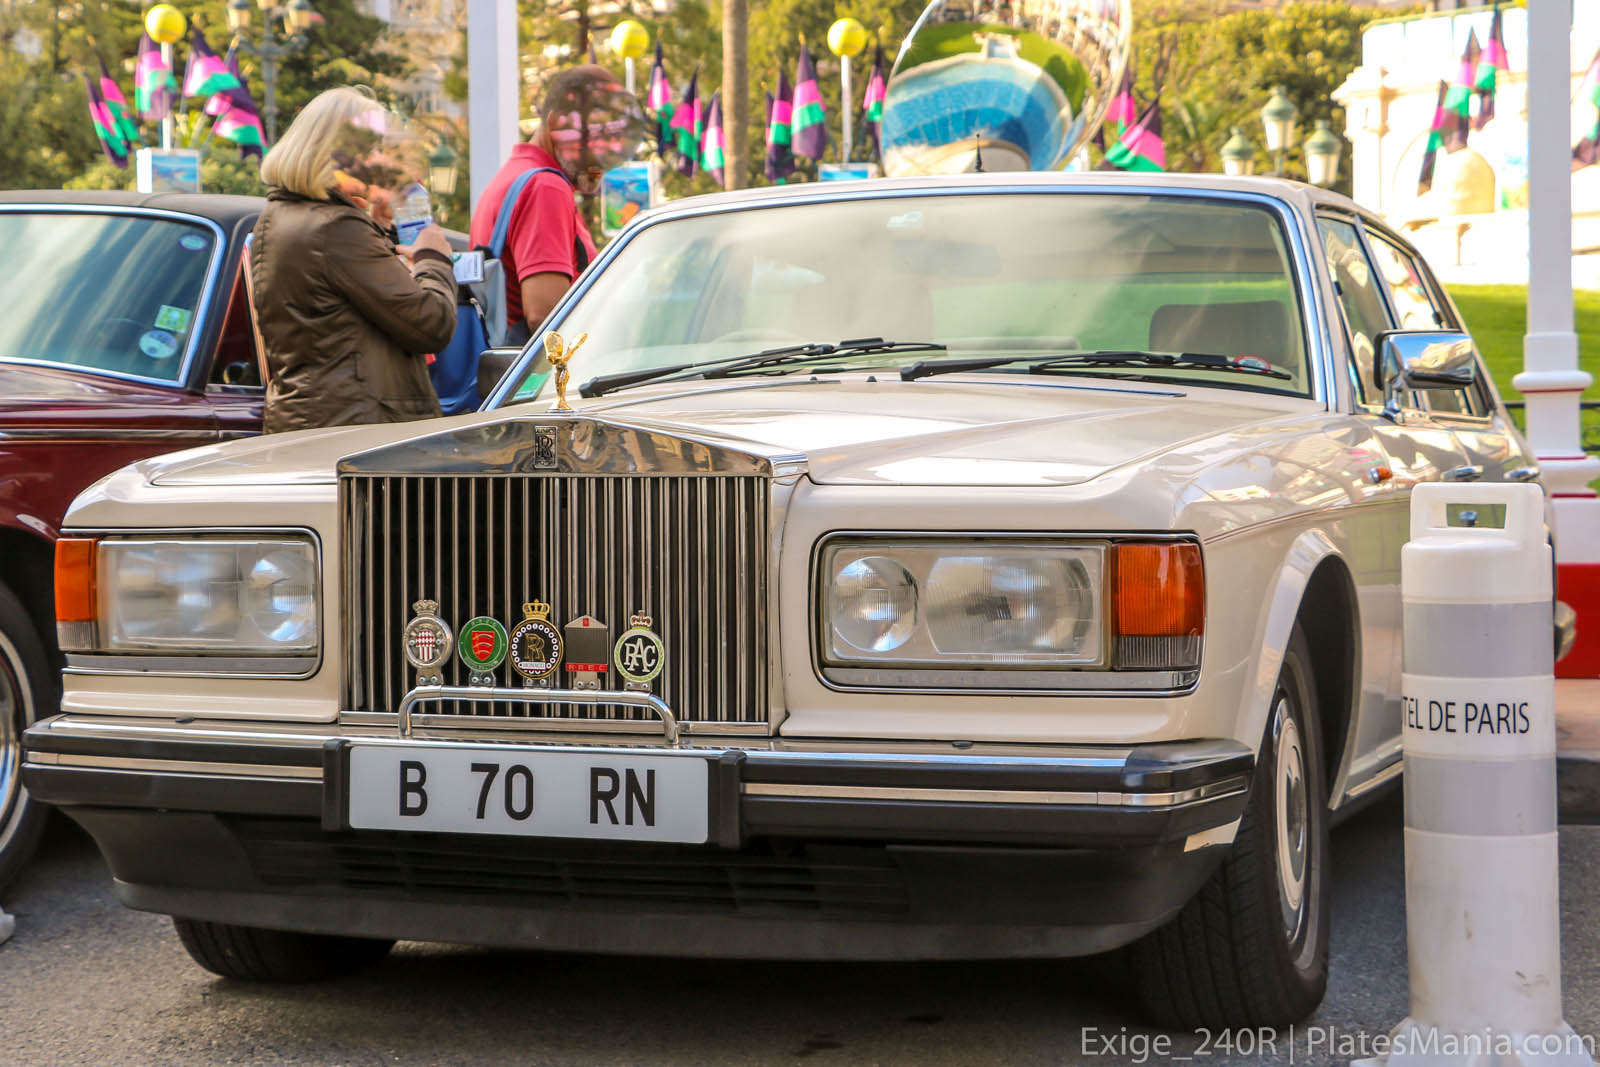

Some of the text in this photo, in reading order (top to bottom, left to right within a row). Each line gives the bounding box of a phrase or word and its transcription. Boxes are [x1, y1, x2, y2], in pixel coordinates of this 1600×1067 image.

[623, 637, 656, 672] RAC
[1429, 700, 1456, 733] DE
[1465, 702, 1530, 734] PARIS
[399, 760, 656, 827] B 70 RN
